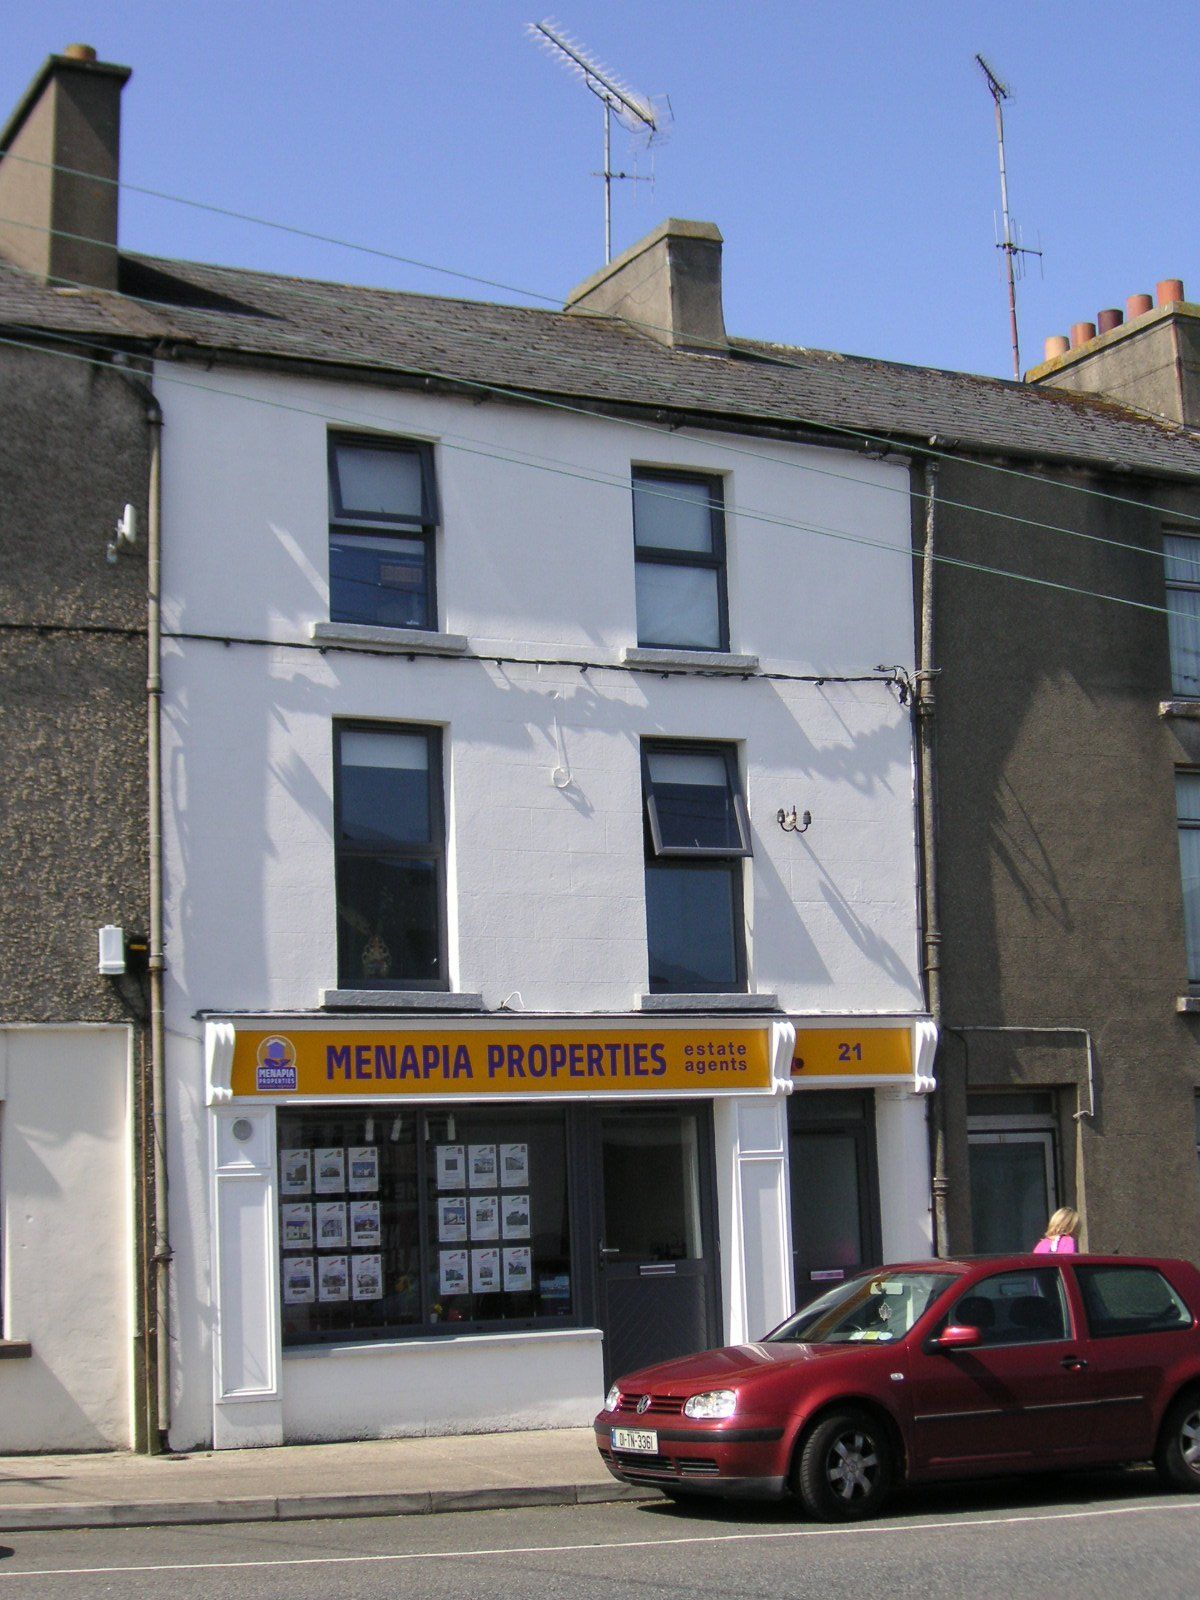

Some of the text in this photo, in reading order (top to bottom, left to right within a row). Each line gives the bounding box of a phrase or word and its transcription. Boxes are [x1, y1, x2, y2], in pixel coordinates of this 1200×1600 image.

[684, 1041, 747, 1056] estate
[838, 1042, 862, 1061] 21
[326, 1043, 667, 1080] MENAPIA PROPERTIES
[684, 1057, 748, 1075] agents
[259, 1068, 295, 1078] MENAPIA
[619, 1432, 653, 1450] 01-TN-3361
